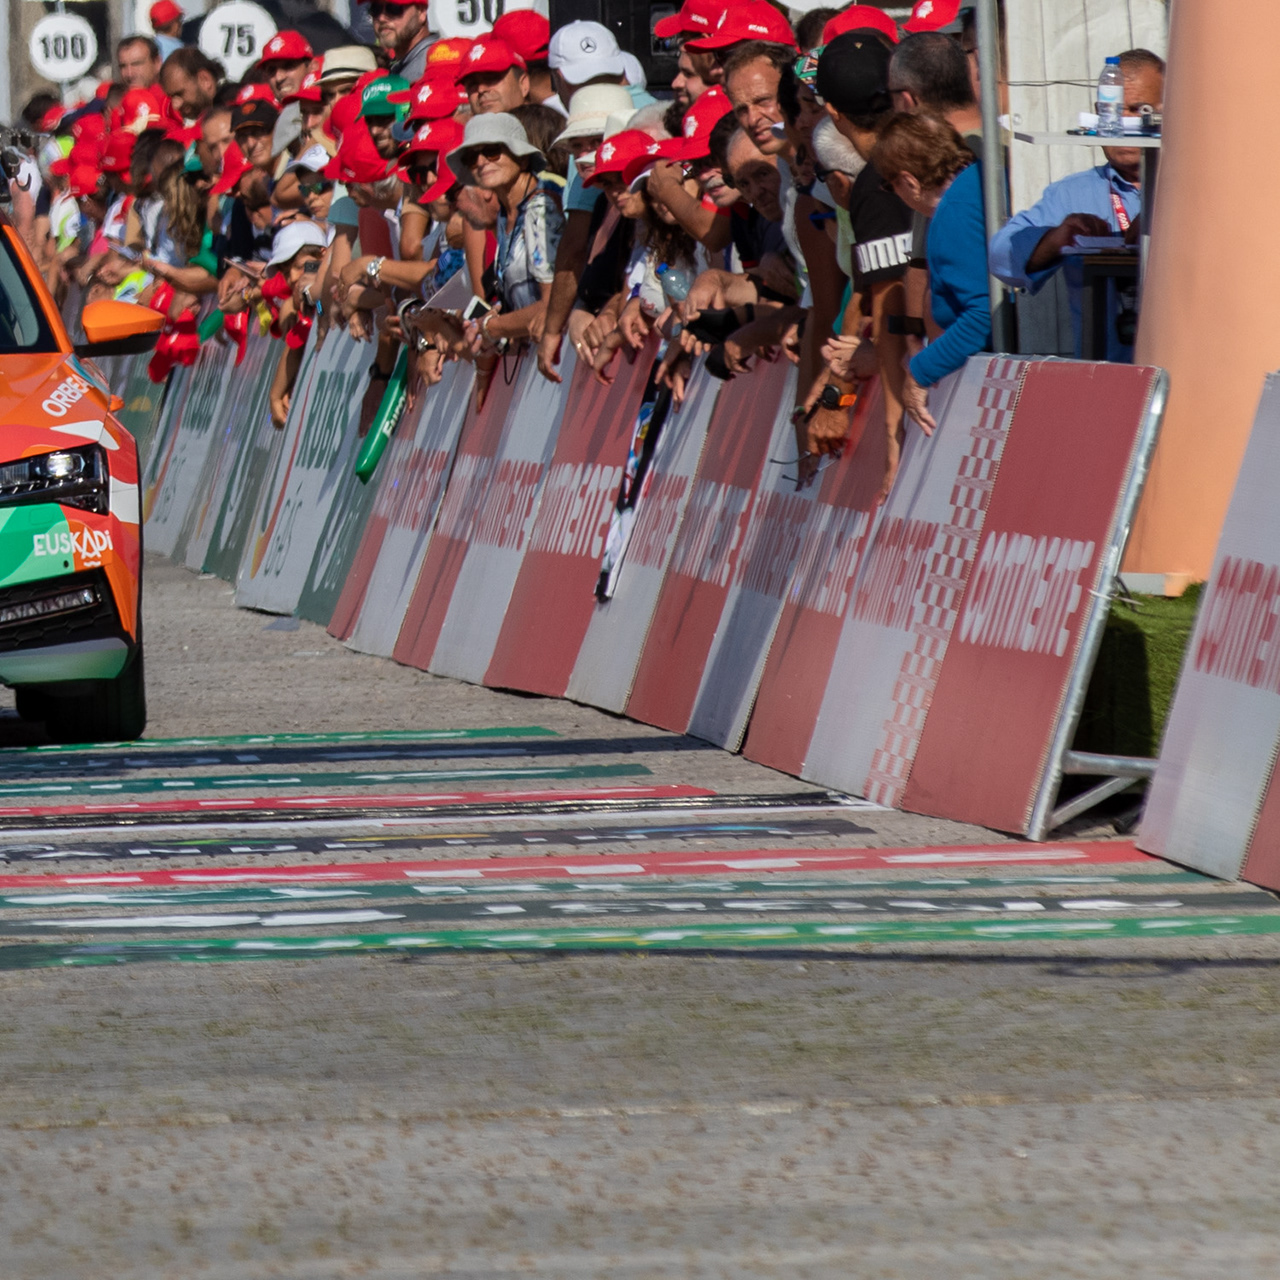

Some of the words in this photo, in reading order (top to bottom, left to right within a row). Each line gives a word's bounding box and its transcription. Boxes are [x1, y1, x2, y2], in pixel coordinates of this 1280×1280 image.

[38, 32, 88, 61] 100
[219, 24, 257, 58] 75
[42, 373, 94, 417] ORBEA
